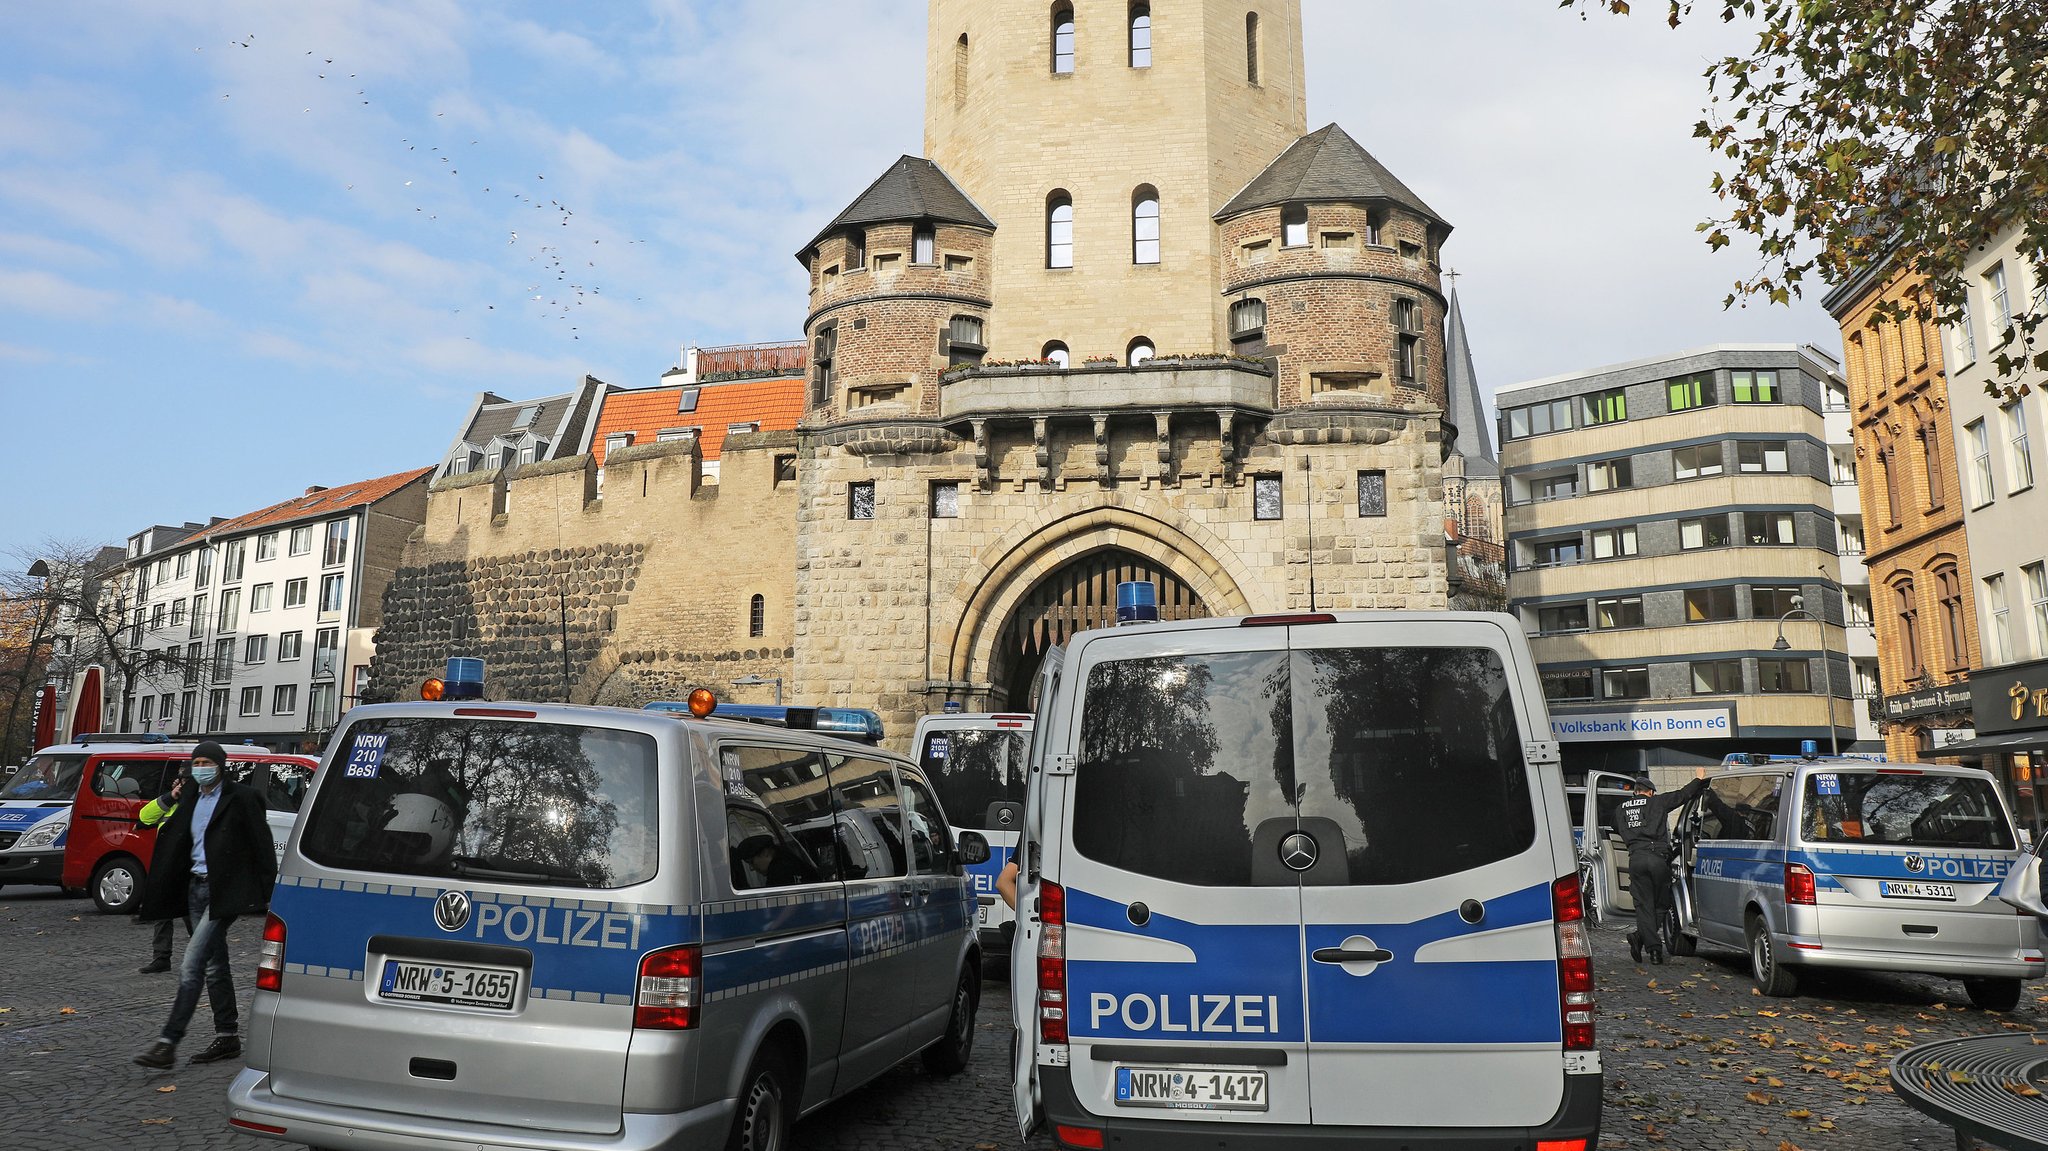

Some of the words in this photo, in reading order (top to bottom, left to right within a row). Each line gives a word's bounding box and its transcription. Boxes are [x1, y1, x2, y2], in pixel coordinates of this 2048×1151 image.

[1558, 720, 1627, 734] Volksbank
[1630, 718, 1662, 732] Köln
[1666, 717, 1703, 730] Bonn
[1706, 716, 1727, 728] eG
[354, 735, 388, 748] NRW
[354, 750, 378, 763] 210
[723, 752, 741, 767] NRW
[346, 763, 377, 778] BeSi
[728, 767, 742, 781] 210
[1621, 798, 1647, 809] POLIZEI
[1625, 808, 1641, 816] NRW
[1700, 858, 1723, 877] POLIZEI
[1886, 883, 1909, 895] NRW
[475, 903, 641, 950] POLIZEI
[860, 914, 906, 955] POLIZEI
[394, 965, 432, 992] NRW
[441, 970, 512, 999] 5-1655
[1090, 992, 1279, 1033] POLIZEI
[1130, 1073, 1172, 1099] NRW
[1184, 1074, 1264, 1102] 4-1417
